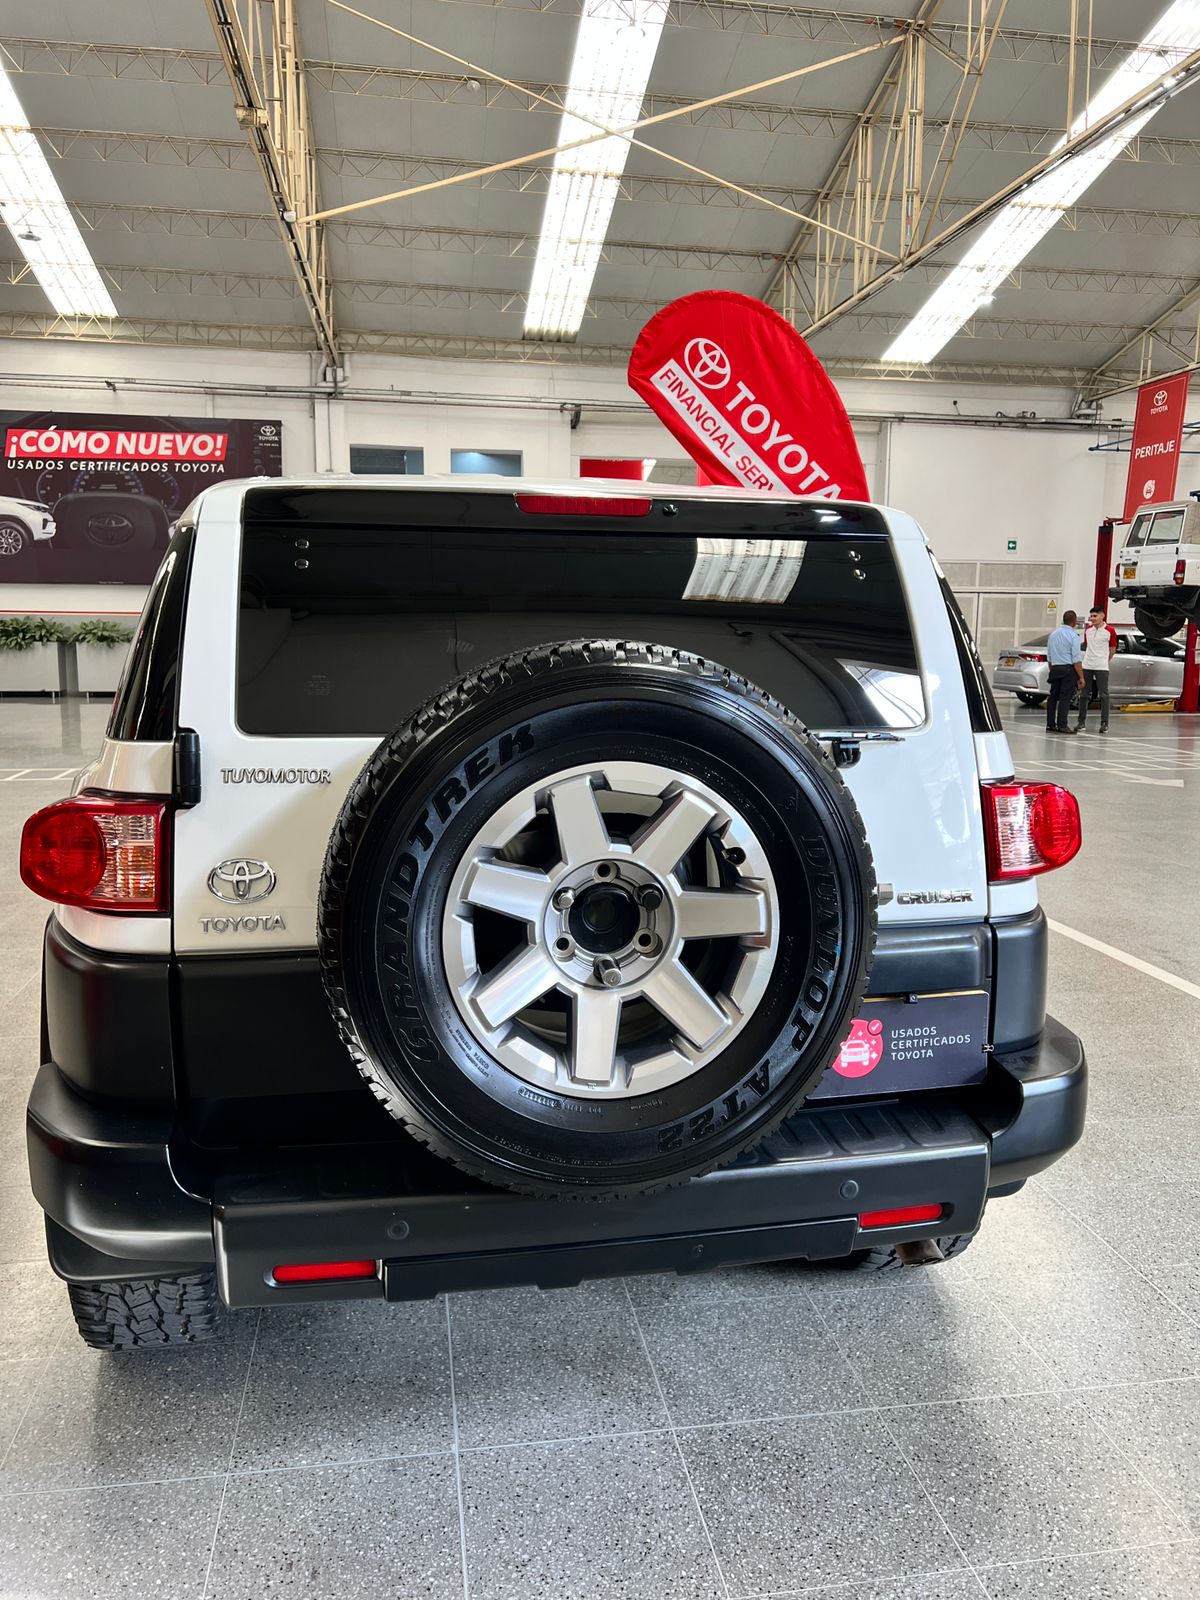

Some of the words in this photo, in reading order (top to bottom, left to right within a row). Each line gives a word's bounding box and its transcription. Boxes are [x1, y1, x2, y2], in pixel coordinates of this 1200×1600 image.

[1151, 404, 1168, 415] TOYOTA
[659, 368, 737, 458] FINANCIAL
[735, 455, 774, 491] SER
[9, 425, 110, 458] ¡CÓMO
[115, 432, 224, 457] NUEVO!
[725, 381, 842, 500] TOYOTA
[1135, 440, 1176, 459] PERITAJE
[7, 460, 64, 470] USADOS
[70, 461, 169, 472] CERTIFICADOS
[174, 463, 225, 473] TOYOTA
[221, 767, 332, 784] TUYOMOTOR
[383, 723, 536, 1063] GRANDTREK
[897, 888, 974, 905] CRUISER
[199, 914, 287, 933] TOYOTA
[790, 834, 841, 1052] DUNLOP
[891, 1026, 937, 1038] USADOS
[891, 1034, 971, 1050] CERTIFICADOS
[891, 1049, 934, 1061] TOYOTA
[657, 1058, 773, 1153] AT22
